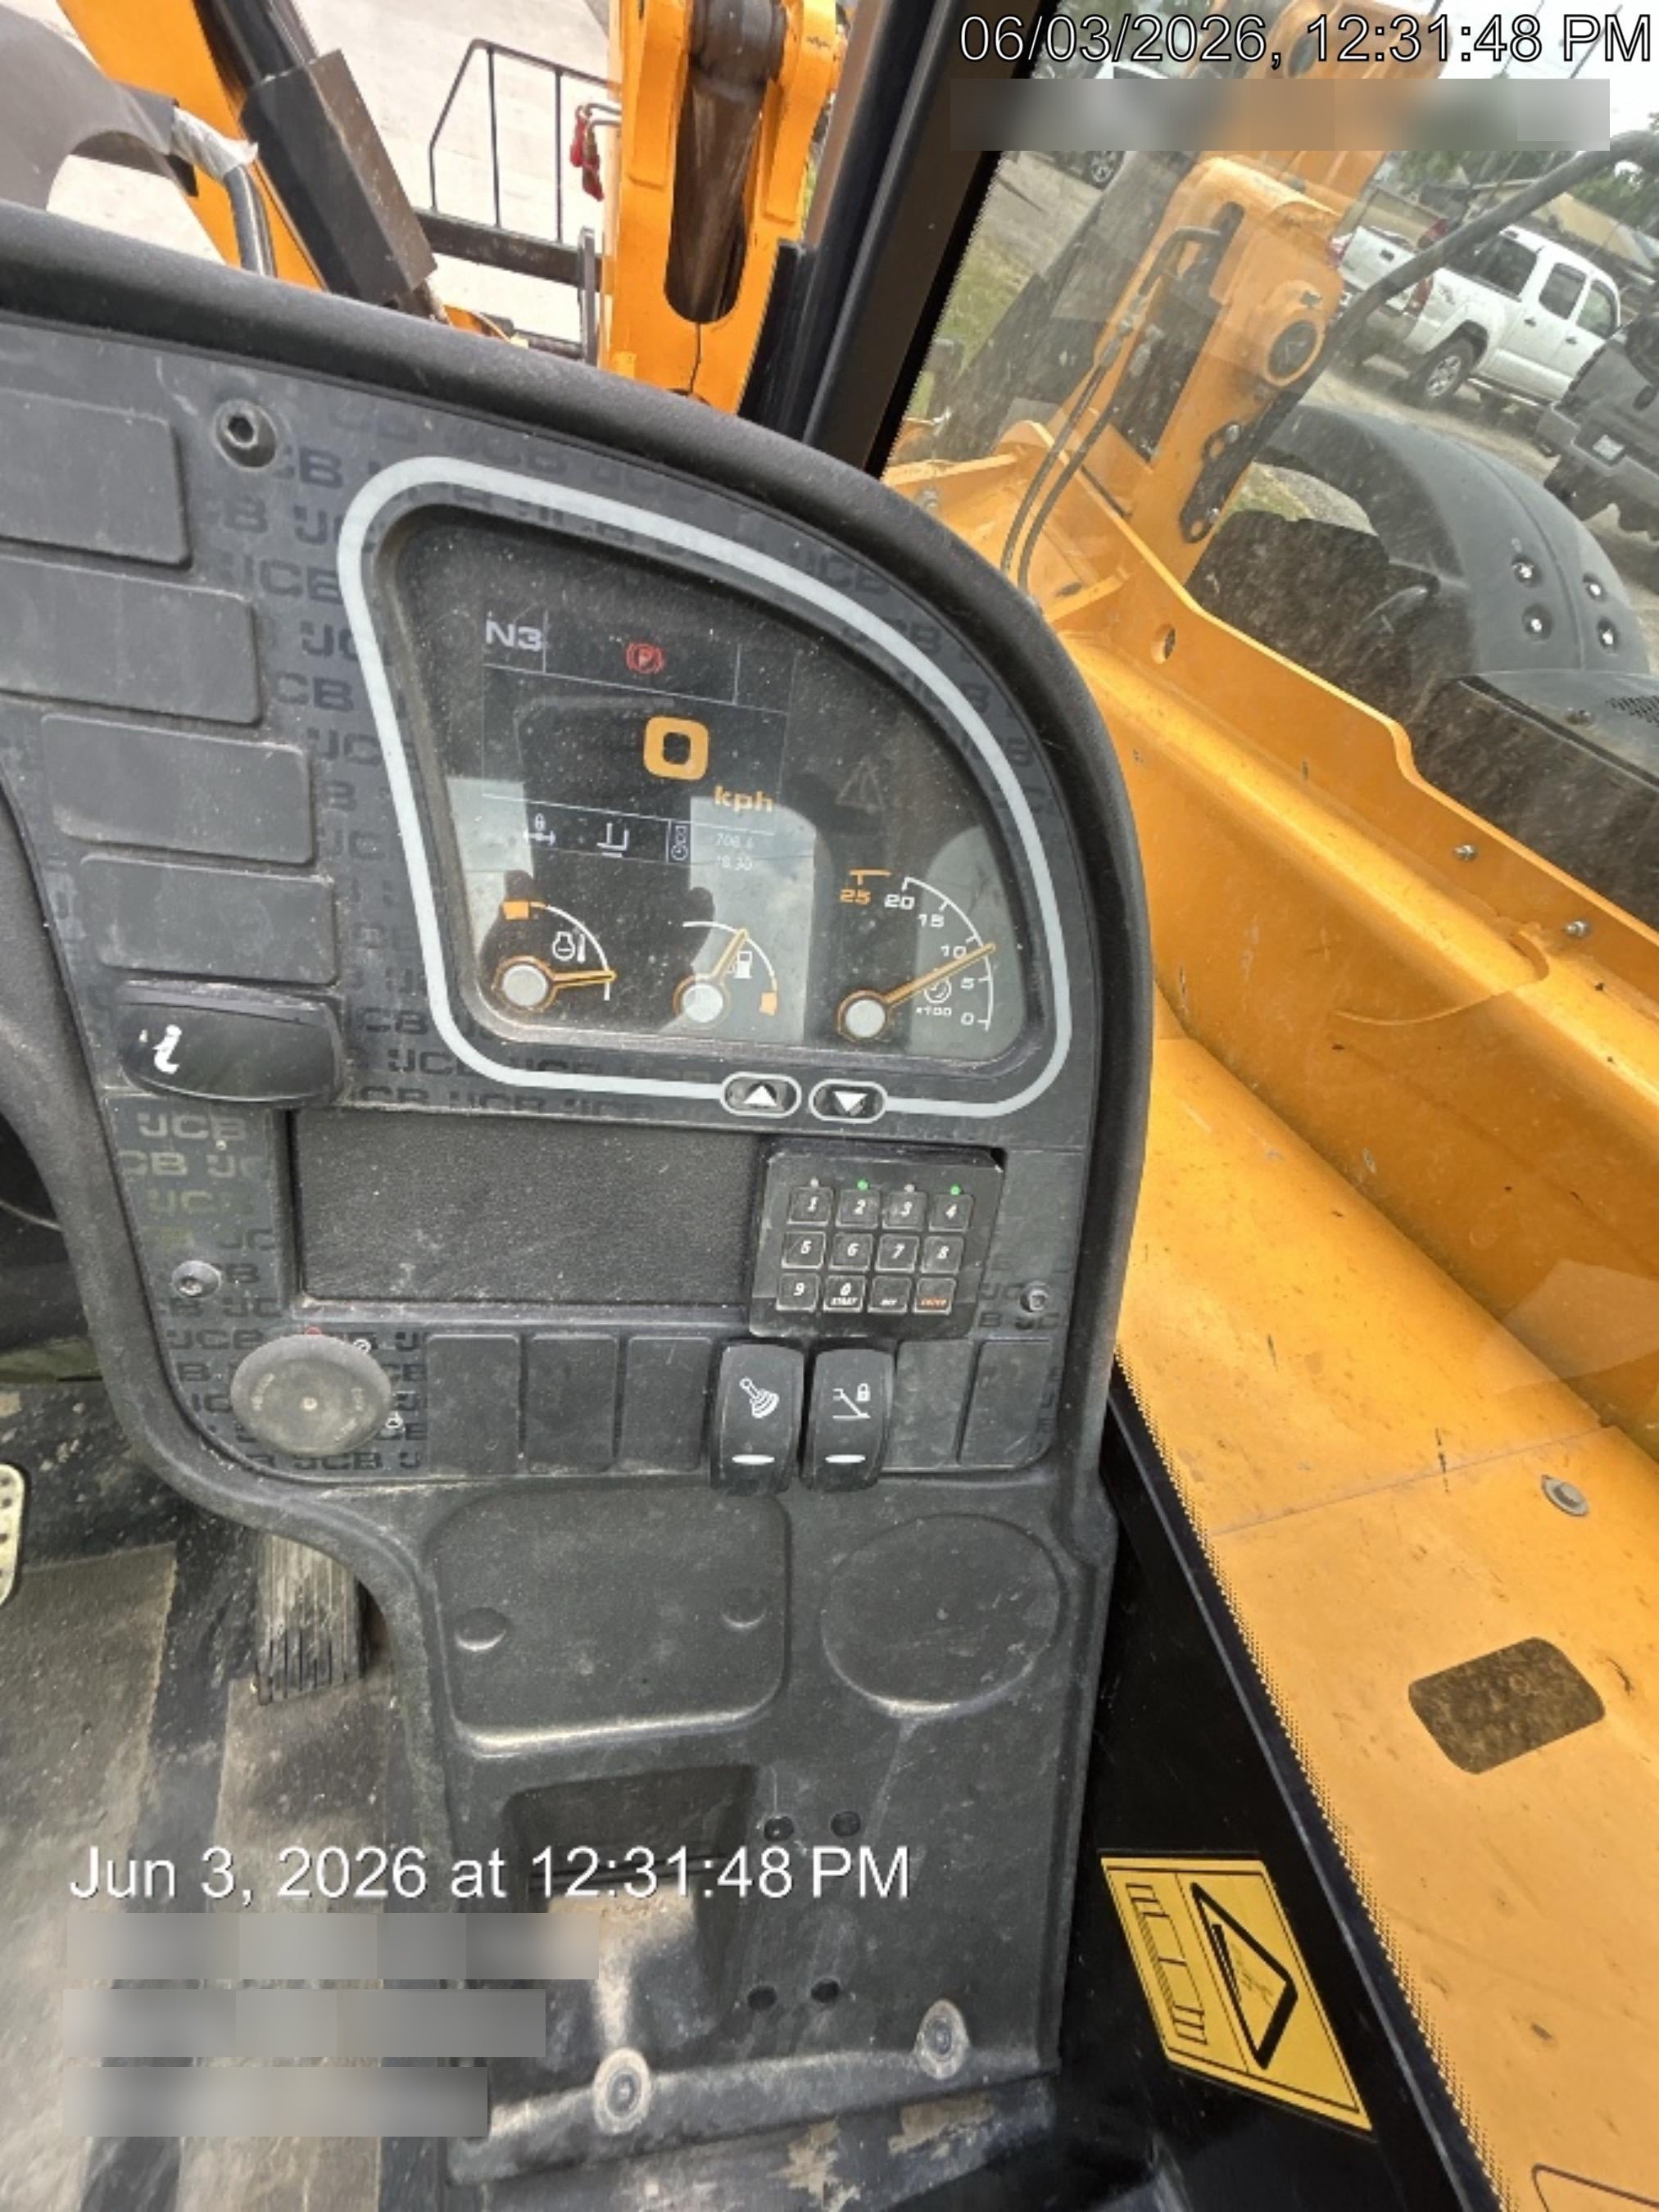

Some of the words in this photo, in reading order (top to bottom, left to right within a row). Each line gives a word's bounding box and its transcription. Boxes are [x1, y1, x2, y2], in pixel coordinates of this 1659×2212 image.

[485, 619, 543, 651] N3
[643, 715, 709, 781] 0
[714, 784, 773, 814] kph
[839, 889, 871, 904] 25
[884, 893, 915, 910] 20
[918, 913, 945, 927] 15
[941, 945, 967, 959] 10
[960, 977, 974, 989] 5
[960, 1012, 974, 1026] 0
[137, 1112, 247, 1141] JCB
[807, 1195, 818, 1212] 1
[853, 1199, 867, 1214] 2
[900, 1201, 913, 1217] 3
[945, 1203, 958, 1219] 4
[800, 1240, 813, 1255] 5
[846, 1241, 859, 1257] 6
[891, 1243, 905, 1258] 7
[936, 1244, 950, 1260] 8
[793, 1282, 805, 1296] 9
[840, 1281, 852, 1296] 0
